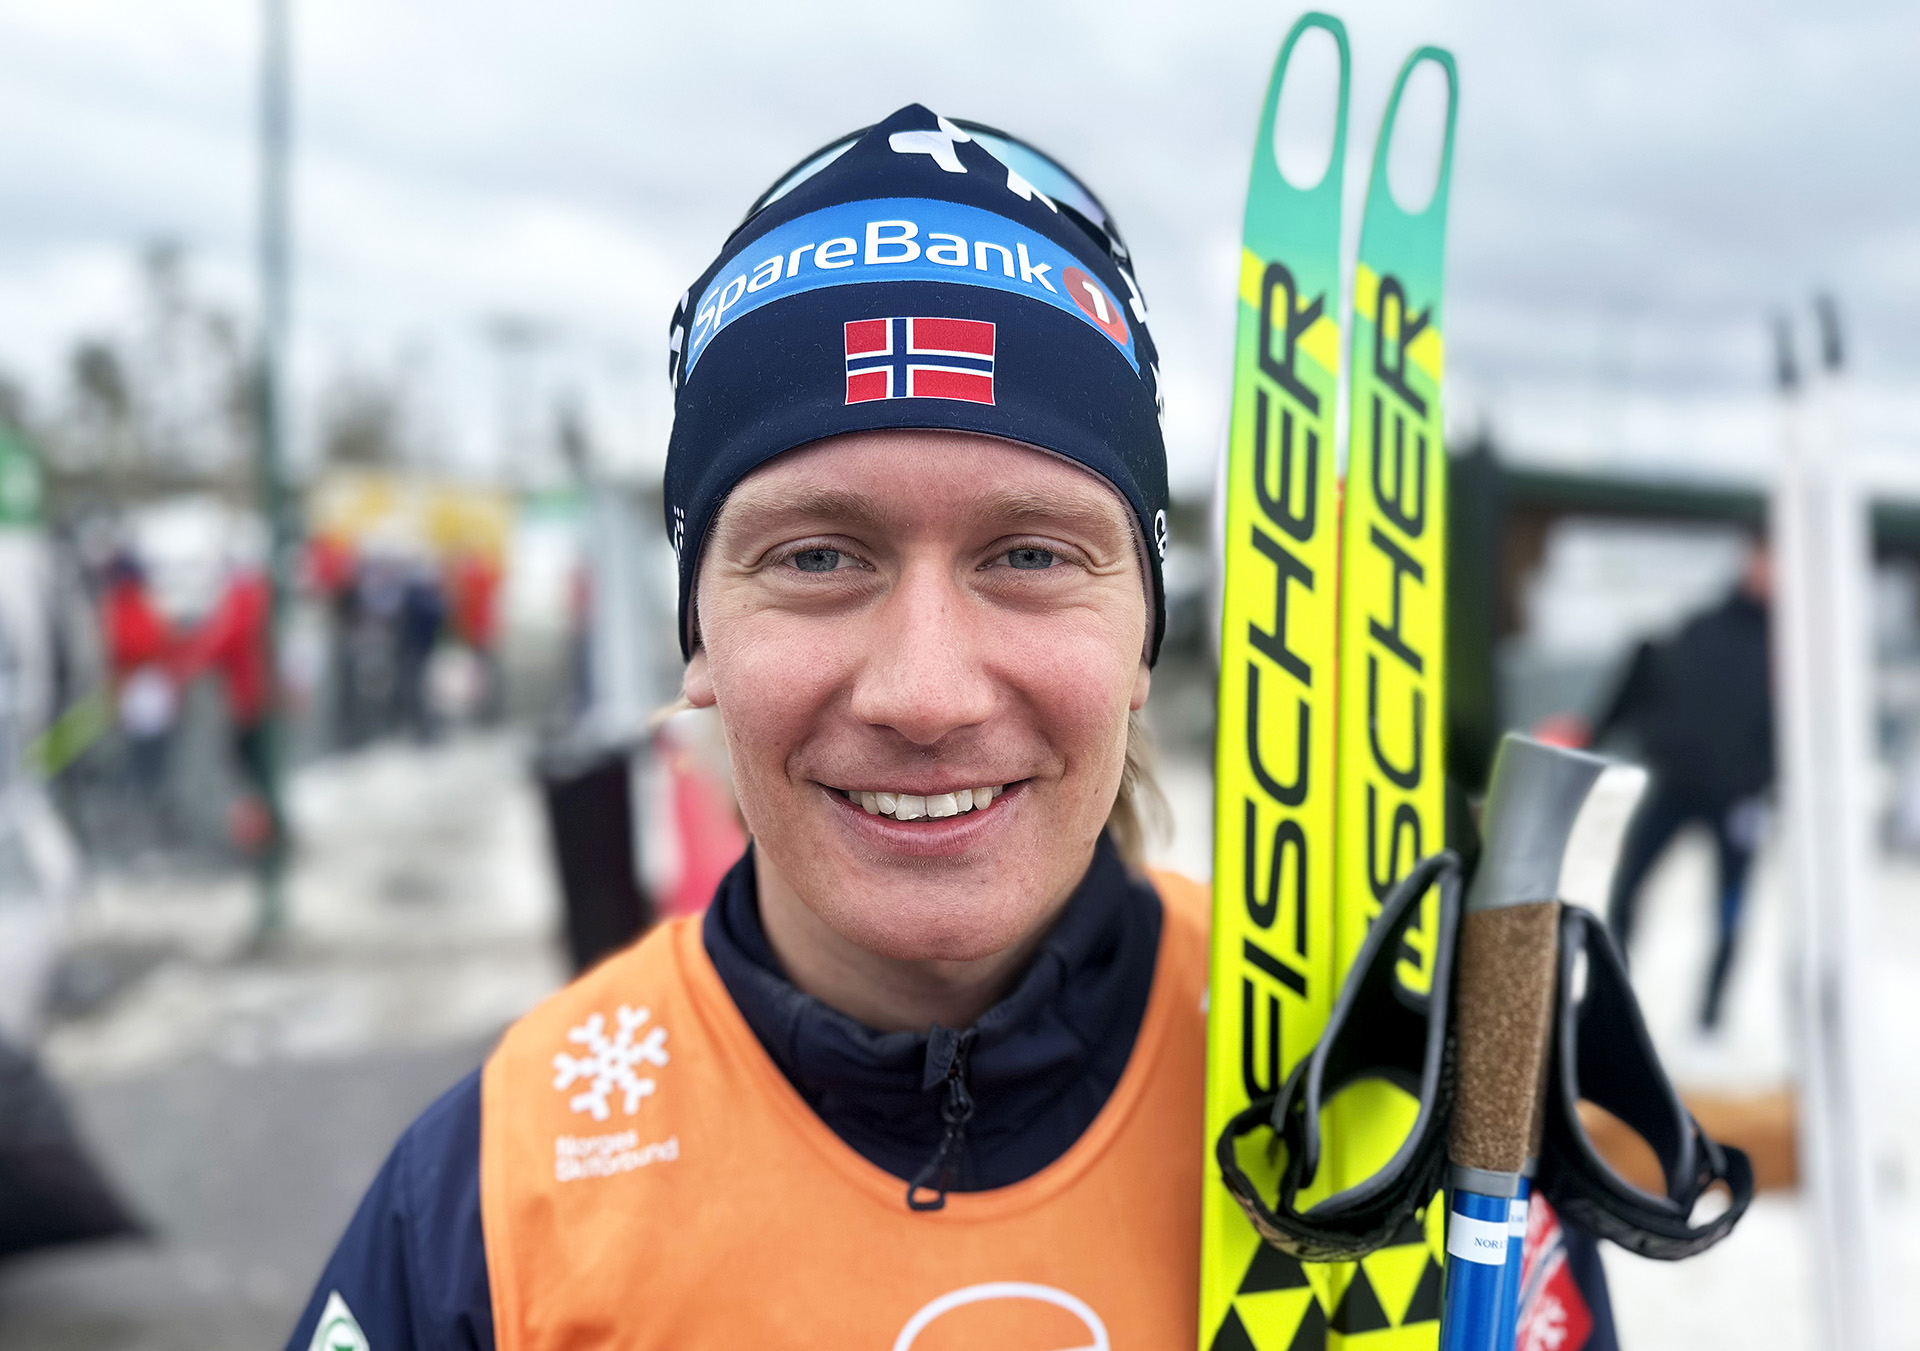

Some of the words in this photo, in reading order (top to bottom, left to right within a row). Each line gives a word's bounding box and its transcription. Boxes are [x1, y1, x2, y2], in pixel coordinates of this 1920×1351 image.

[693, 220, 1059, 350] SpareBank
[1081, 279, 1111, 325] 1
[1366, 273, 1433, 975] SCHER
[1242, 260, 1327, 1102] FISCHER
